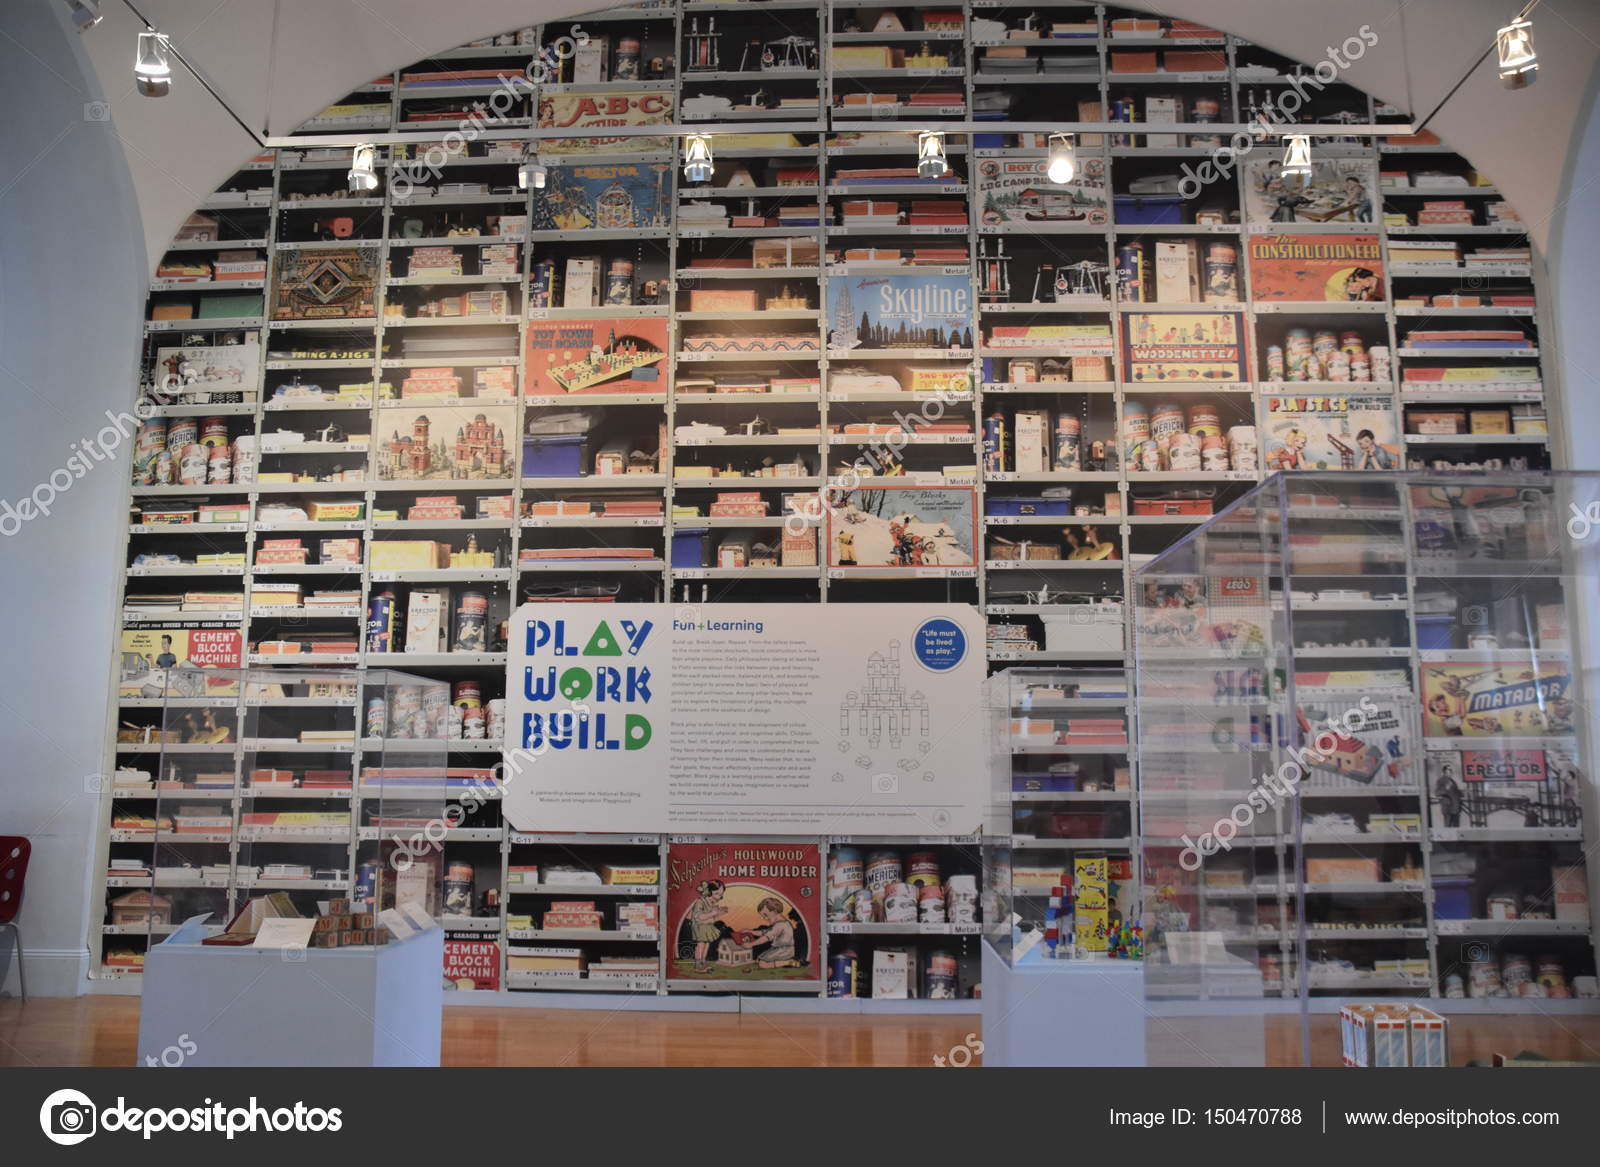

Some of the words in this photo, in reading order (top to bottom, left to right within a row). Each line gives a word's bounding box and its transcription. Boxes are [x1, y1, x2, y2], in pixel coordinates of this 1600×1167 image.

[980, 180, 1001, 191] LOG
[1003, 177, 1032, 188] CAMP
[1252, 244, 1381, 259] CONSTRUCTIONEER
[880, 284, 967, 324] Skyline
[673, 620, 695, 631] Fun
[707, 620, 764, 633] Learning
[193, 632, 236, 642] CEMENT
[526, 620, 653, 656] PLAY
[197, 643, 232, 653] BLOCK
[190, 654, 238, 663] MACHINE
[524, 666, 652, 704] WORK
[1474, 682, 1562, 711] MATADOR
[522, 713, 652, 750] BUILD
[1465, 763, 1542, 777] ERECTOR
[734, 850, 804, 861] HOLLYWOOD
[719, 865, 755, 877] HOME
[761, 866, 817, 878] BUILDER
[443, 944, 495, 955] CEMENT
[449, 956, 491, 966] BLOCK
